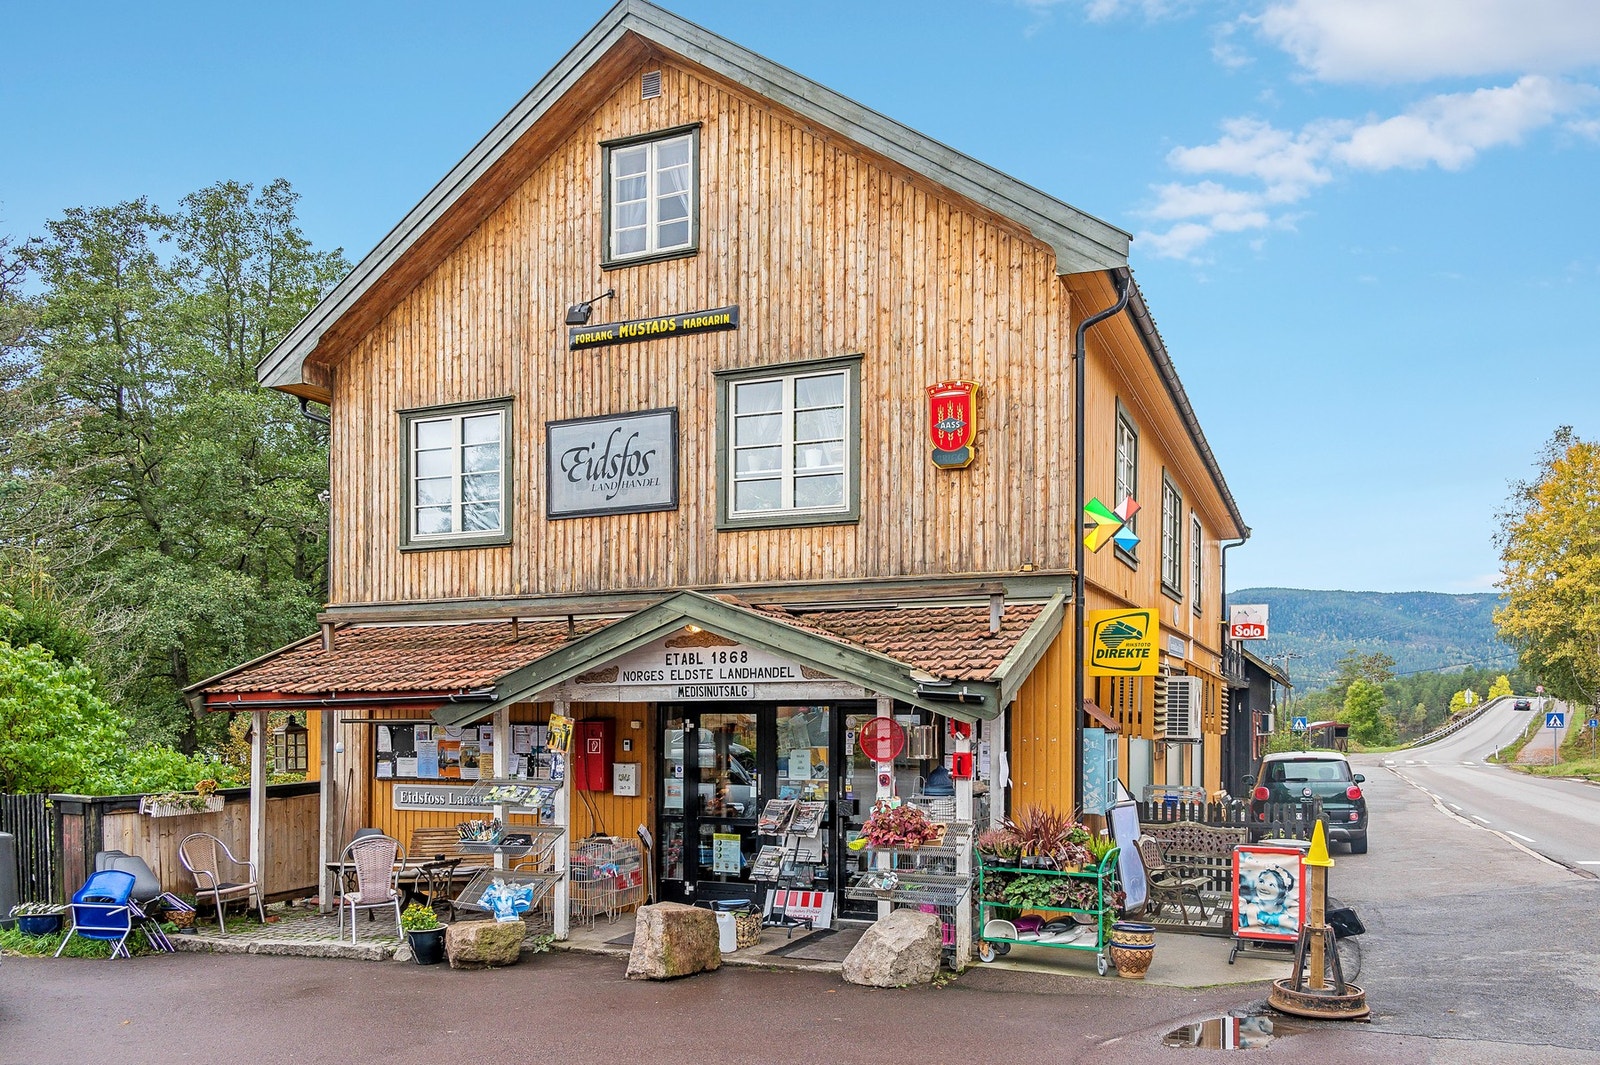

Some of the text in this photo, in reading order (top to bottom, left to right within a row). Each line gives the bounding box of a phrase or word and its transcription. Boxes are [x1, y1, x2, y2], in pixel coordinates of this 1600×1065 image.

[576, 314, 730, 344] FORLANG MUSTADS MARGARIN
[941, 421, 960, 430] AASS
[560, 427, 656, 501] Eidsfos
[1235, 625, 1262, 637] Solo
[711, 650, 749, 665] 1868
[1096, 648, 1151, 659] DIREKTE
[622, 666, 795, 682] NORGES ELDSTE LANDHANDEL
[677, 685, 748, 698] MEDISINUTSALG
[399, 791, 446, 805] Eidsfoss
